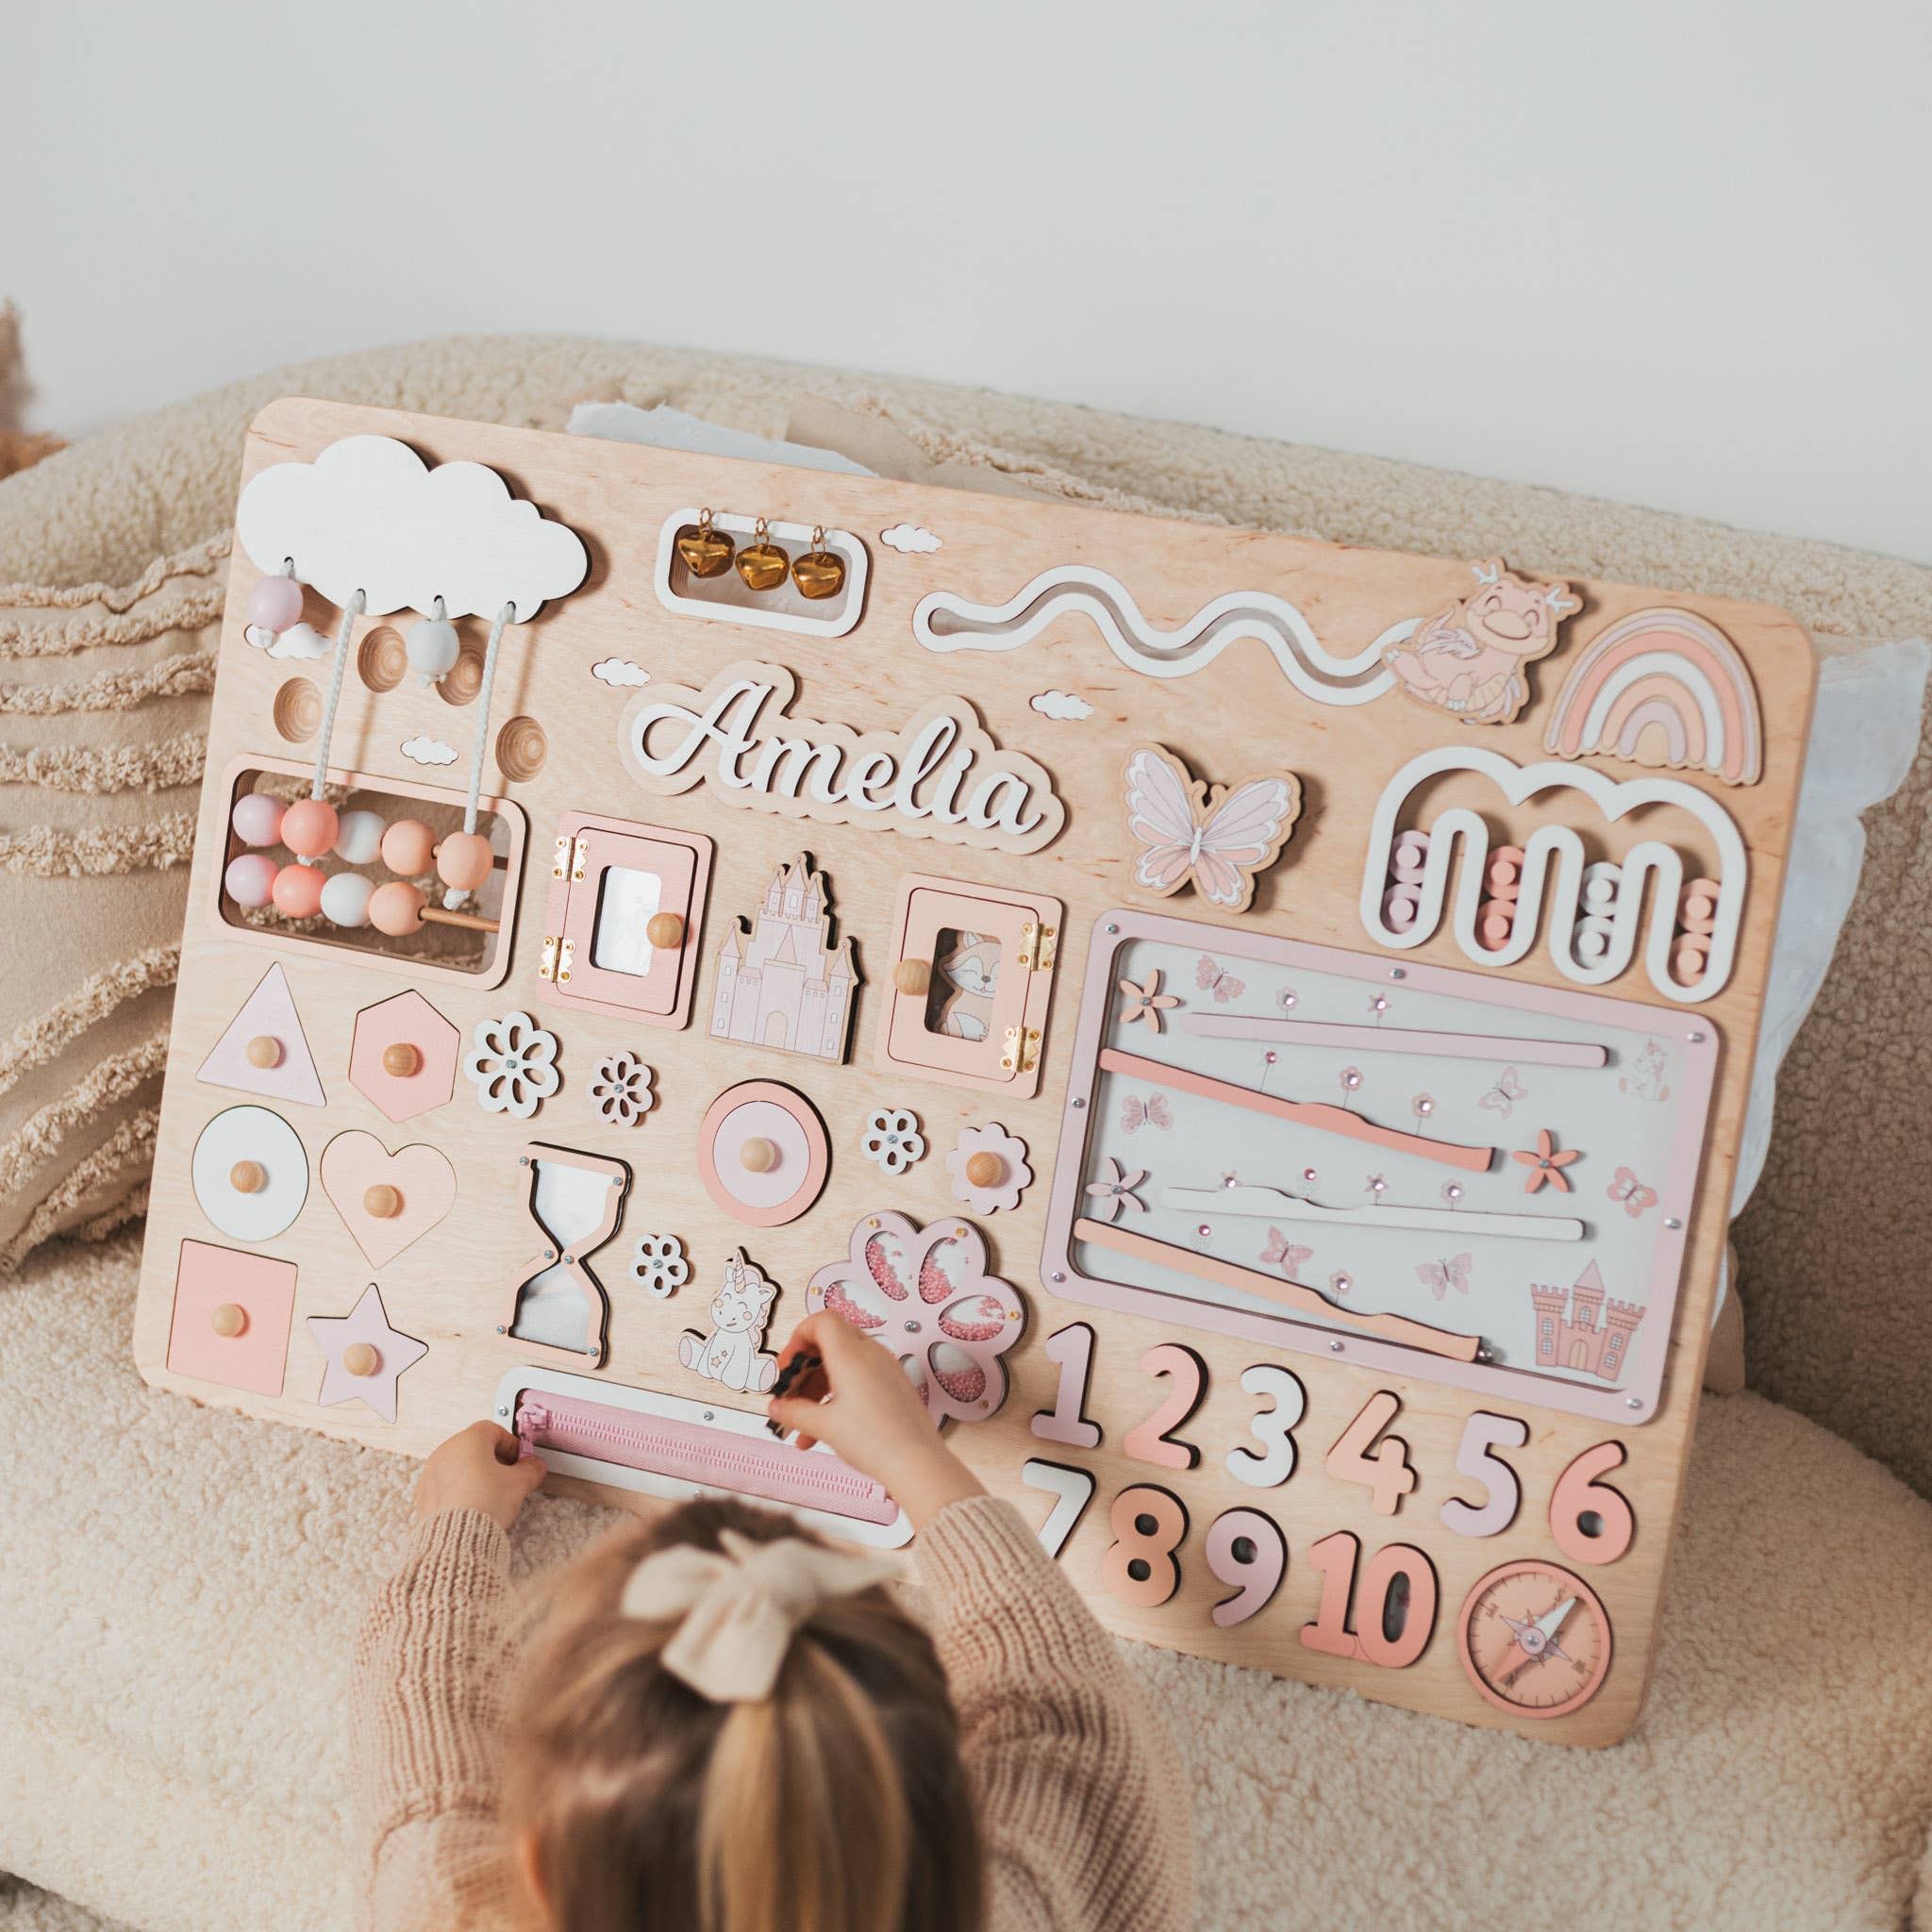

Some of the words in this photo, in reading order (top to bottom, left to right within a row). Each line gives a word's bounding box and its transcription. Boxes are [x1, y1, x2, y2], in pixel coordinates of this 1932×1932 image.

[631, 680, 1041, 834] Amelia
[1030, 1322, 1102, 1448] 1
[1124, 1343, 1208, 1470] 2
[1226, 1363, 1307, 1488] 3
[1325, 1390, 1417, 1515] 4
[1440, 1409, 1530, 1538] 5
[1549, 1440, 1636, 1565] 6
[1022, 1457, 1096, 1559] 7
[1103, 1483, 1190, 1607] 8
[1206, 1507, 1288, 1627] 9
[1300, 1530, 1440, 1669] 10
